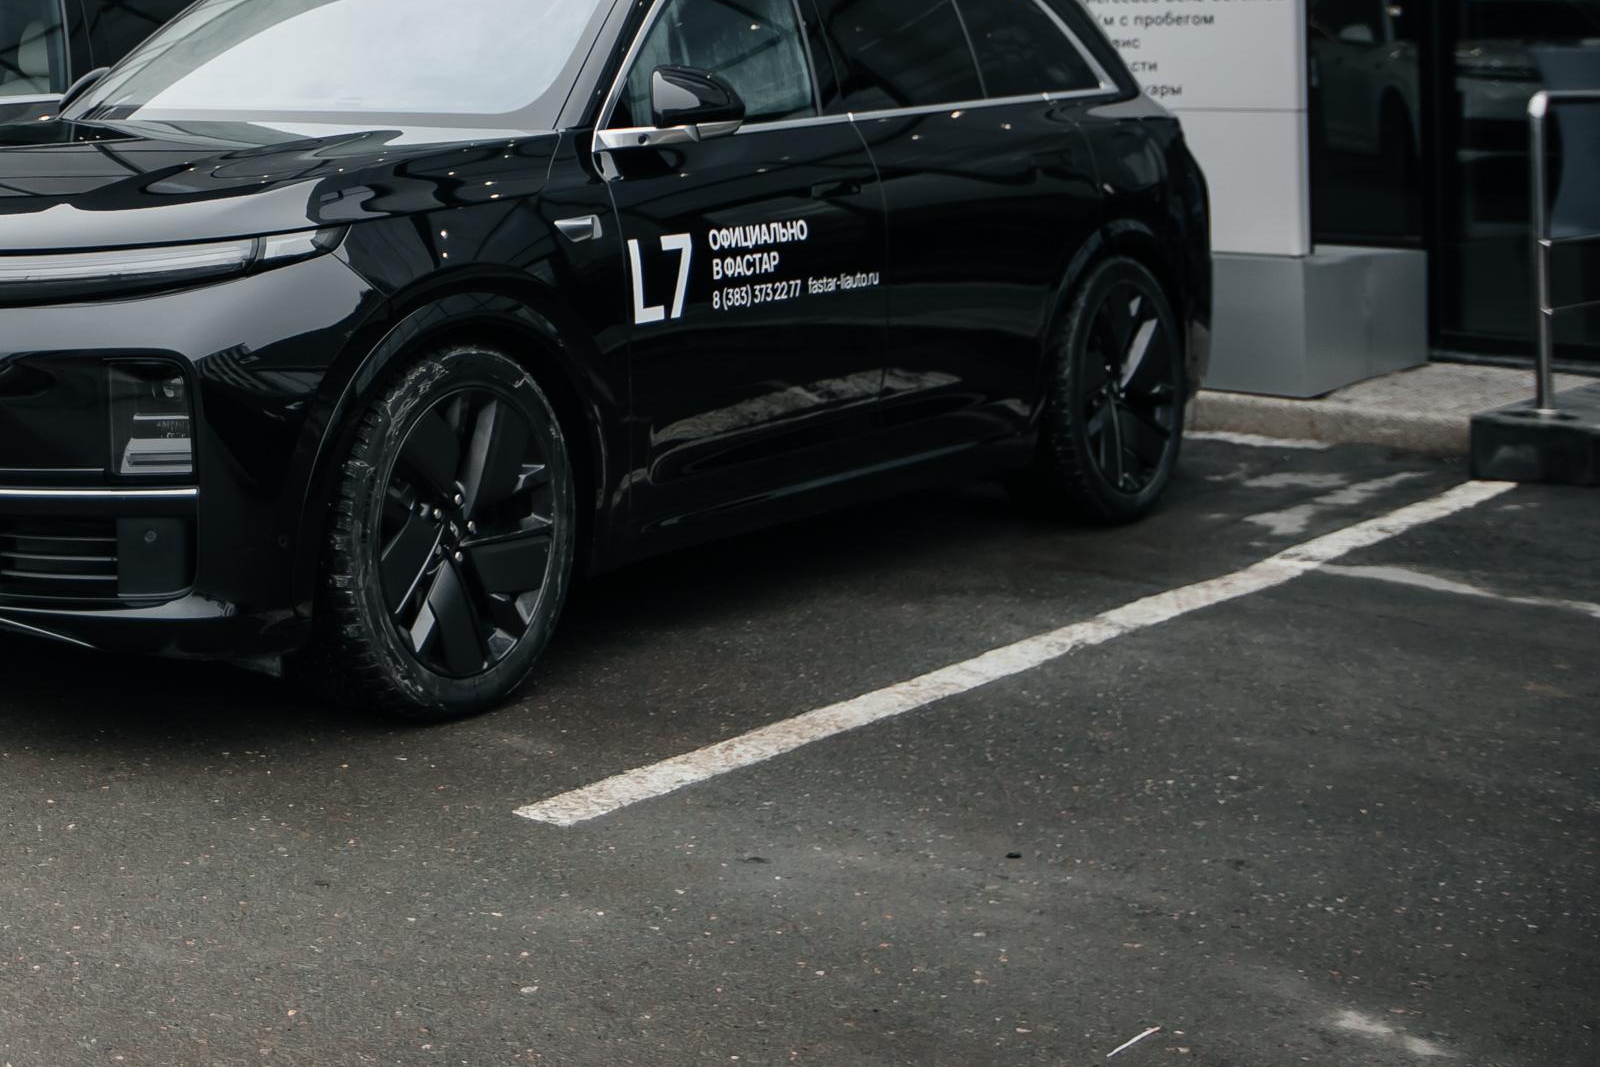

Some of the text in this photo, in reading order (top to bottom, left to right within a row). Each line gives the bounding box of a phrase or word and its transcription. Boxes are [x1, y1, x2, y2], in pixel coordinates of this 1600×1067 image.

[1119, 15, 1129, 26] с
[1133, 12, 1215, 29] пробегом
[708, 219, 808, 250] ОФИЦИАЛЬНО
[627, 233, 692, 325] L7
[712, 251, 780, 280] В ФАСТАР
[712, 291, 721, 310] 8
[722, 285, 752, 311] (383)
[753, 283, 773, 304] 373
[808, 270, 880, 295] fastar-liauto.ru
